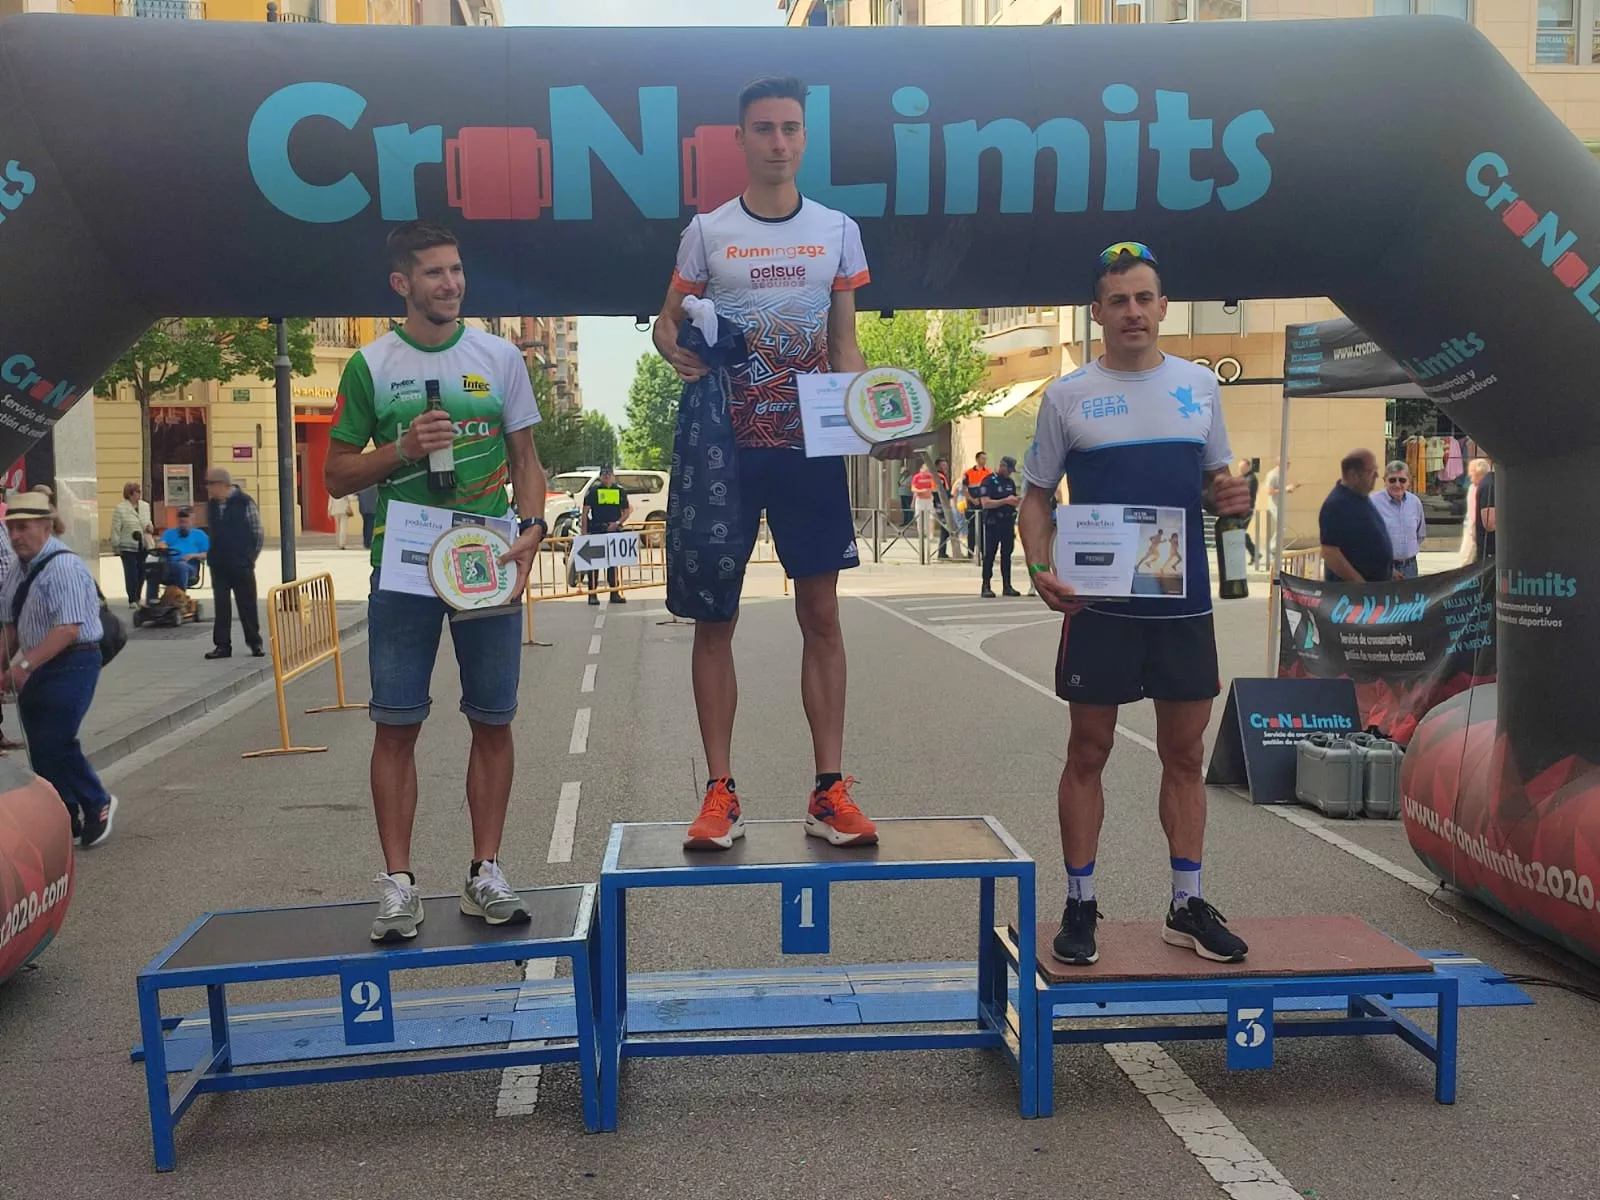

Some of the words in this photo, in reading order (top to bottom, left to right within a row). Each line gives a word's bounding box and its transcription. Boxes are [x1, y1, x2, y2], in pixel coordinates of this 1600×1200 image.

[726, 245, 826, 259] Runningzgz
[1082, 393, 1126, 410] COIX
[1082, 405, 1129, 420] TEAM
[396, 420, 490, 444] Hsca
[610, 538, 637, 557] 10K
[1502, 569, 1577, 598] Limits
[794, 887, 815, 928] 1
[350, 981, 383, 1023] 2
[1235, 1008, 1266, 1047] 3
